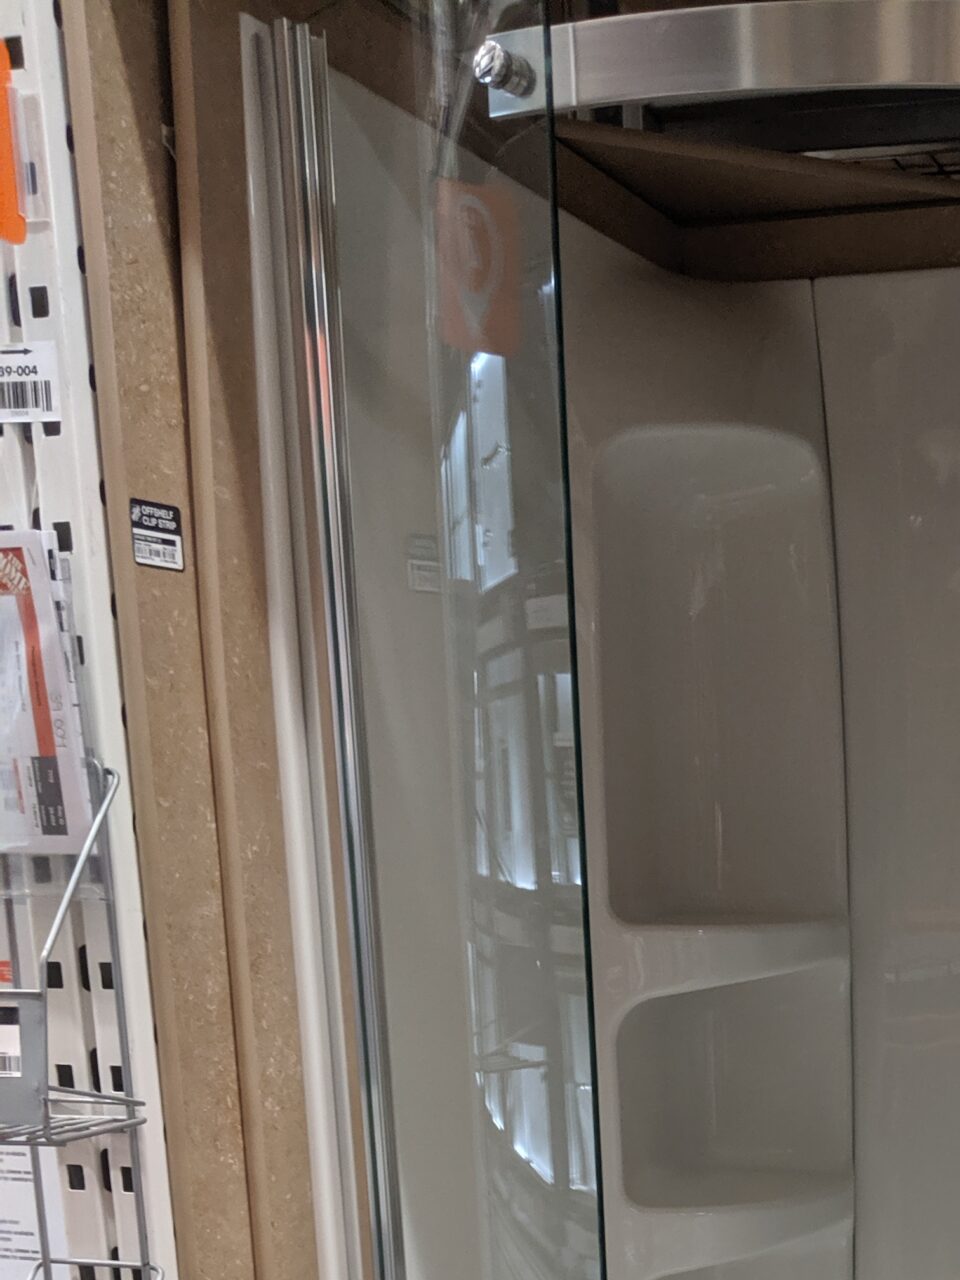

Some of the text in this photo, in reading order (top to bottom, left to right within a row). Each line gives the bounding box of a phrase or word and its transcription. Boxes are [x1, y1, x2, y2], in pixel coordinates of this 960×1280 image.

[141, 505, 174, 520] OFFSHELF
[142, 516, 177, 531] CLIP STRIP
